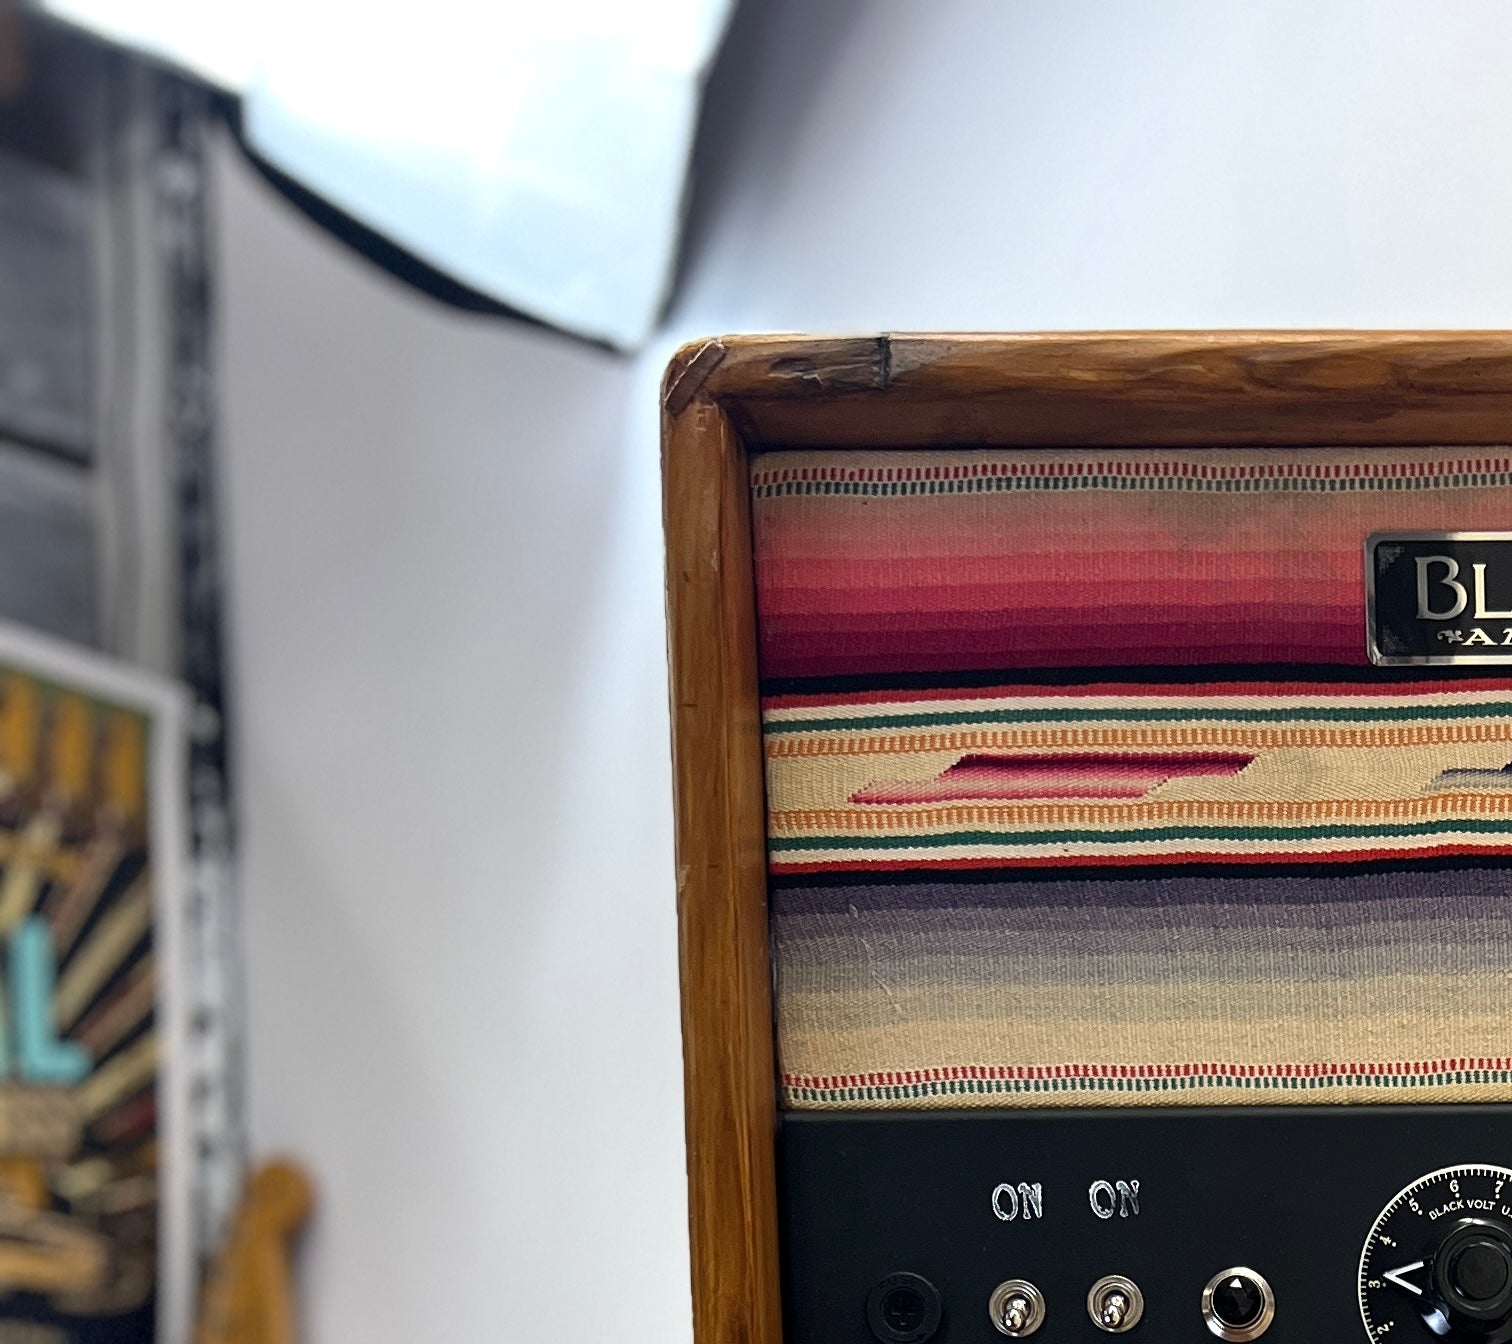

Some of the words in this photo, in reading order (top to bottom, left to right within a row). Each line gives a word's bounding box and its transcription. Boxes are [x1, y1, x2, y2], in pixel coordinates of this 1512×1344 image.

[1450, 1180, 1460, 1193] 6
[1494, 1181, 1504, 1193] 7
[991, 1182, 1043, 1221] ON
[1088, 1179, 1140, 1219] ON
[1409, 1198, 1420, 1213] 5
[1428, 1199, 1465, 1221] BLACK
[1467, 1199, 1496, 1212] VOLT
[1380, 1235, 1392, 1247] 4
[1369, 1280, 1381, 1289] 3
[1377, 1324, 1390, 1335] 2
